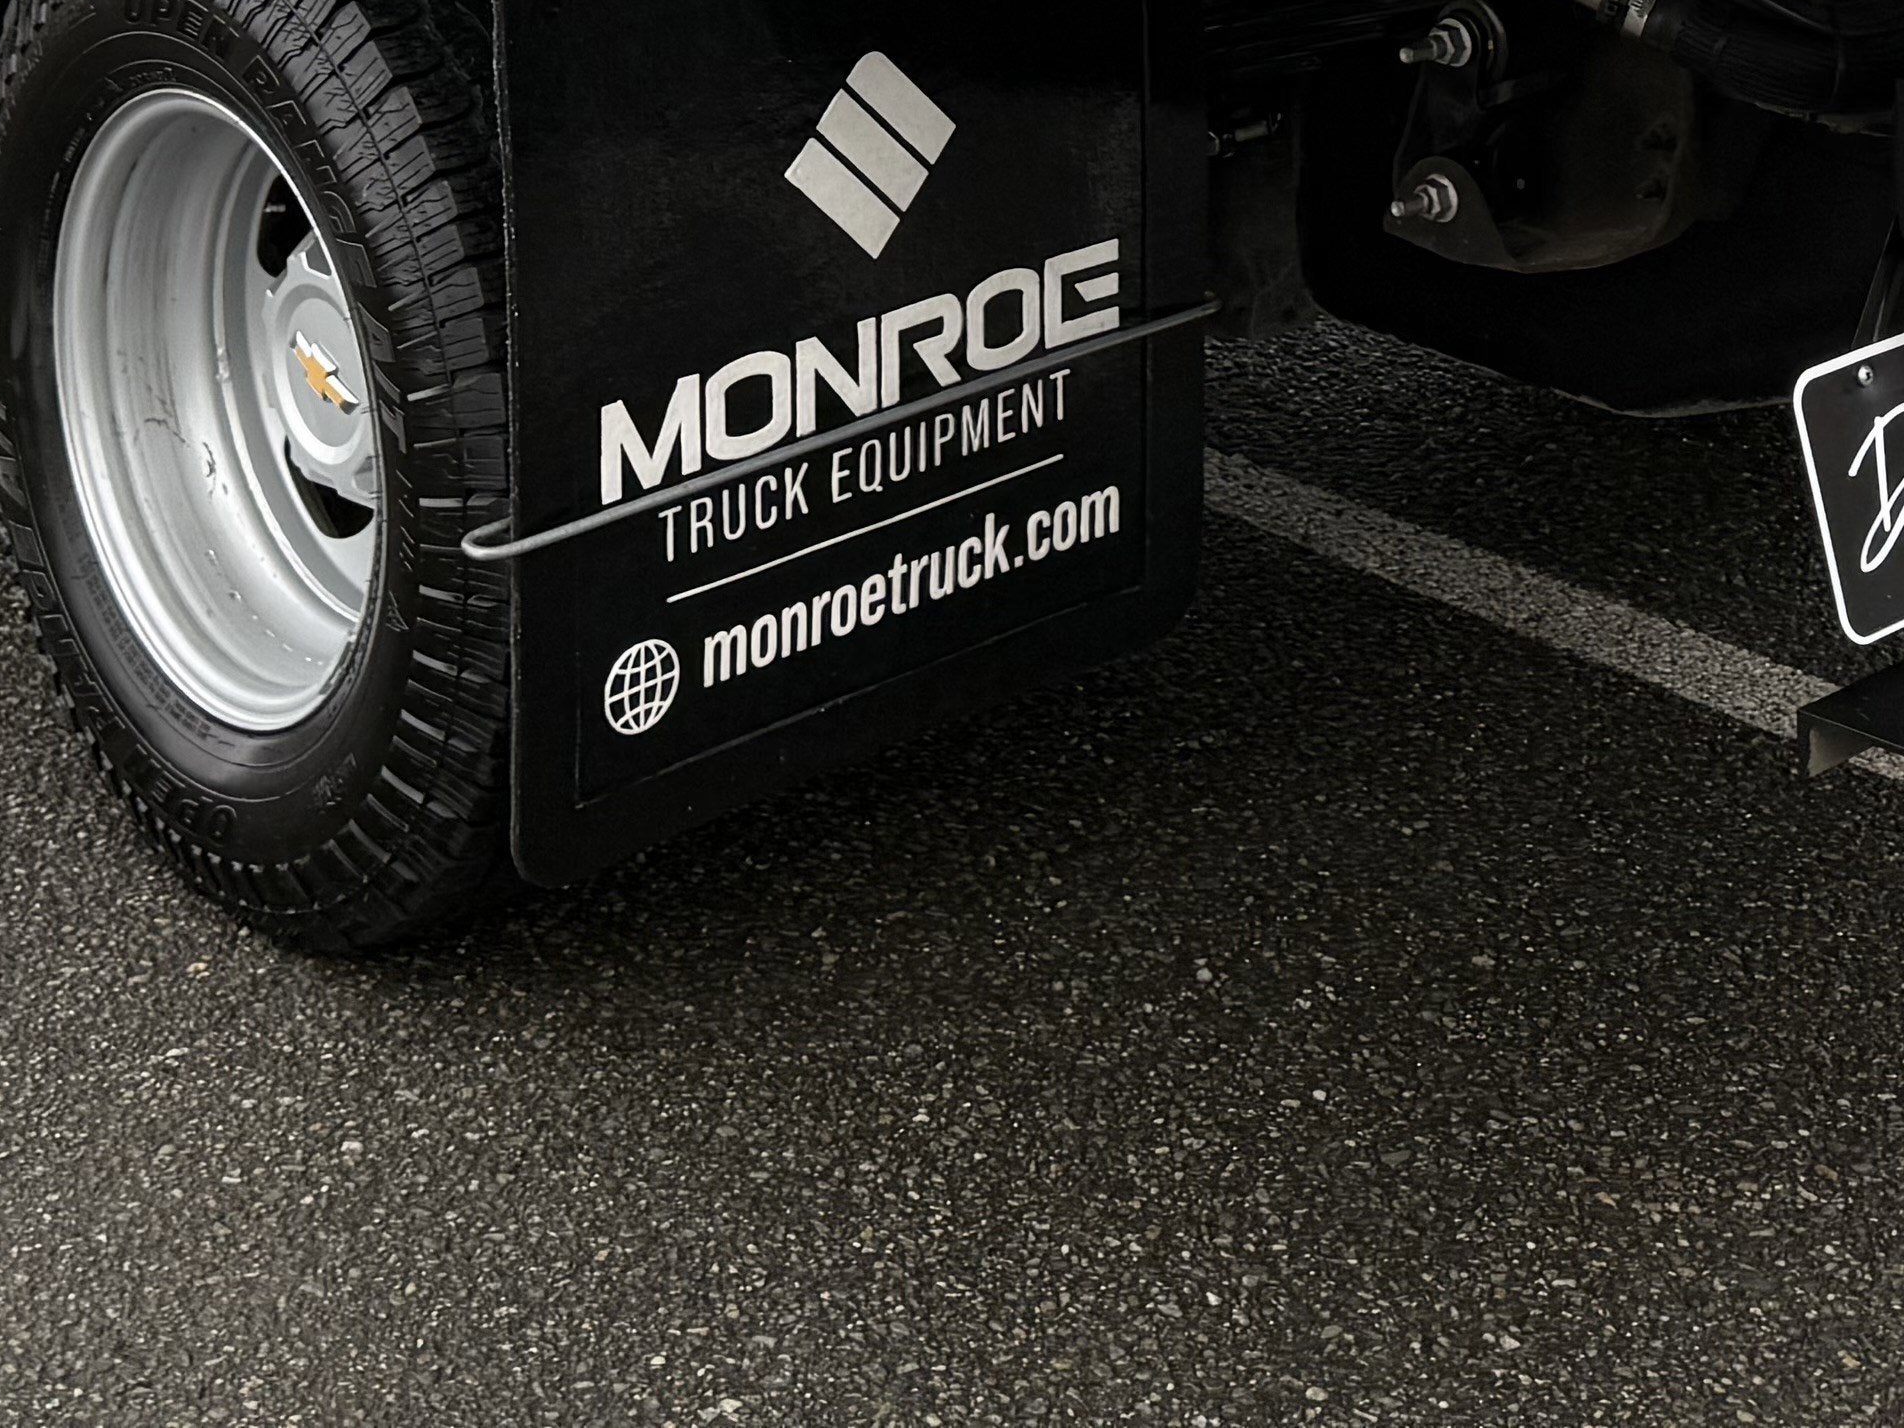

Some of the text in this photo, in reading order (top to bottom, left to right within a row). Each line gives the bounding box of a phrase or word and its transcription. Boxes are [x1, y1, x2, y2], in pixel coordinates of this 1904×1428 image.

[600, 237, 1120, 506] MONROE
[658, 368, 1072, 562] TRUCK EQUIPMENT
[702, 483, 1121, 688] monroetruck.com
